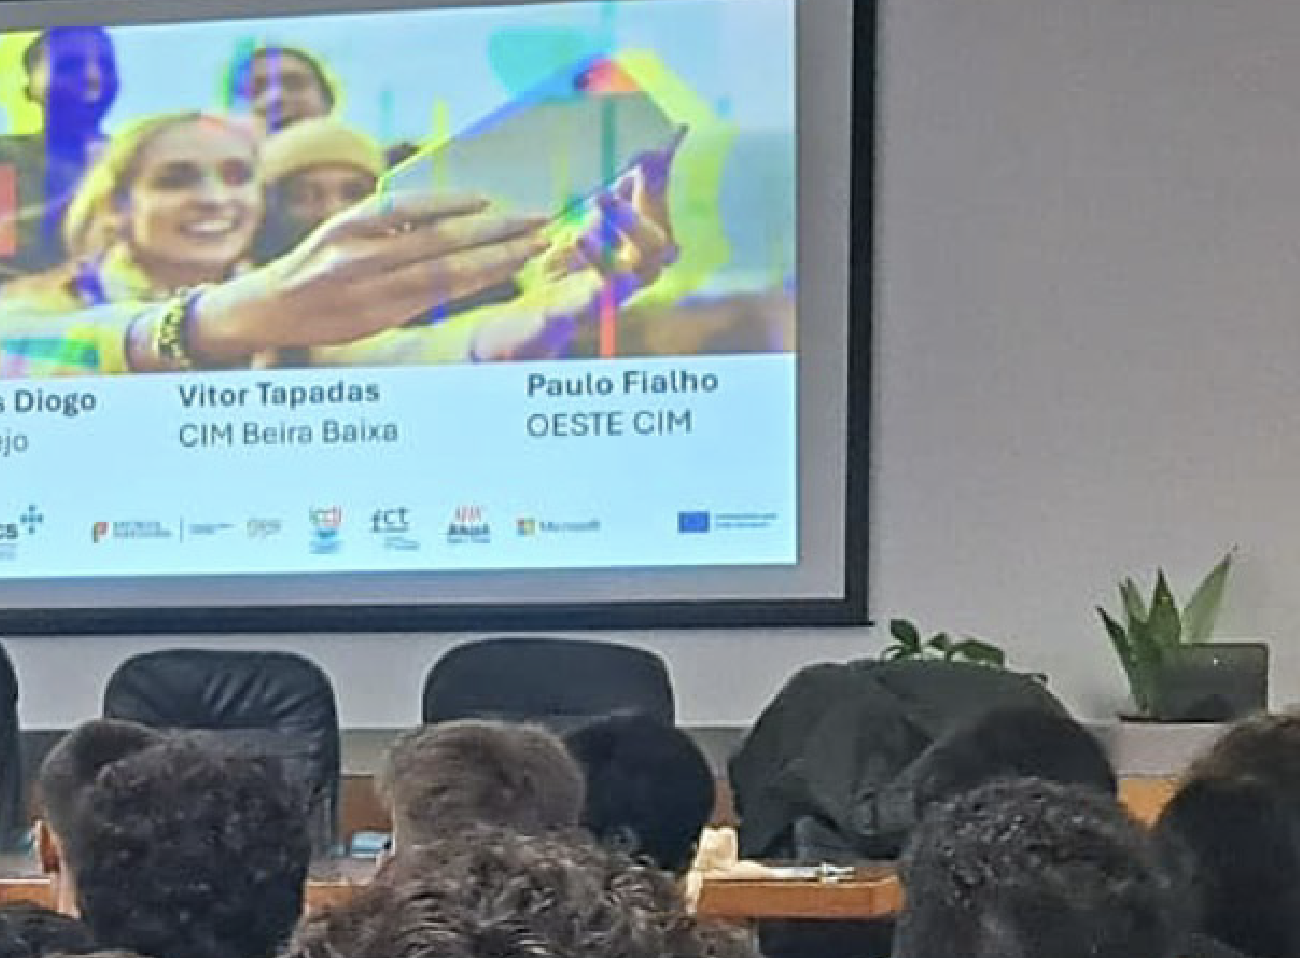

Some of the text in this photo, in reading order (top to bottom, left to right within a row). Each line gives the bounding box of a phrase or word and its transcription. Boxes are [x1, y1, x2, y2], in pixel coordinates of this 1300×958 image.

[256, 380, 380, 410] Tapadas
[527, 369, 719, 397] Paulo Fialho
[14, 388, 97, 418] Diogo
[180, 418, 398, 448] CIM Beira Baixa
[527, 409, 692, 437] OESTE CIM
